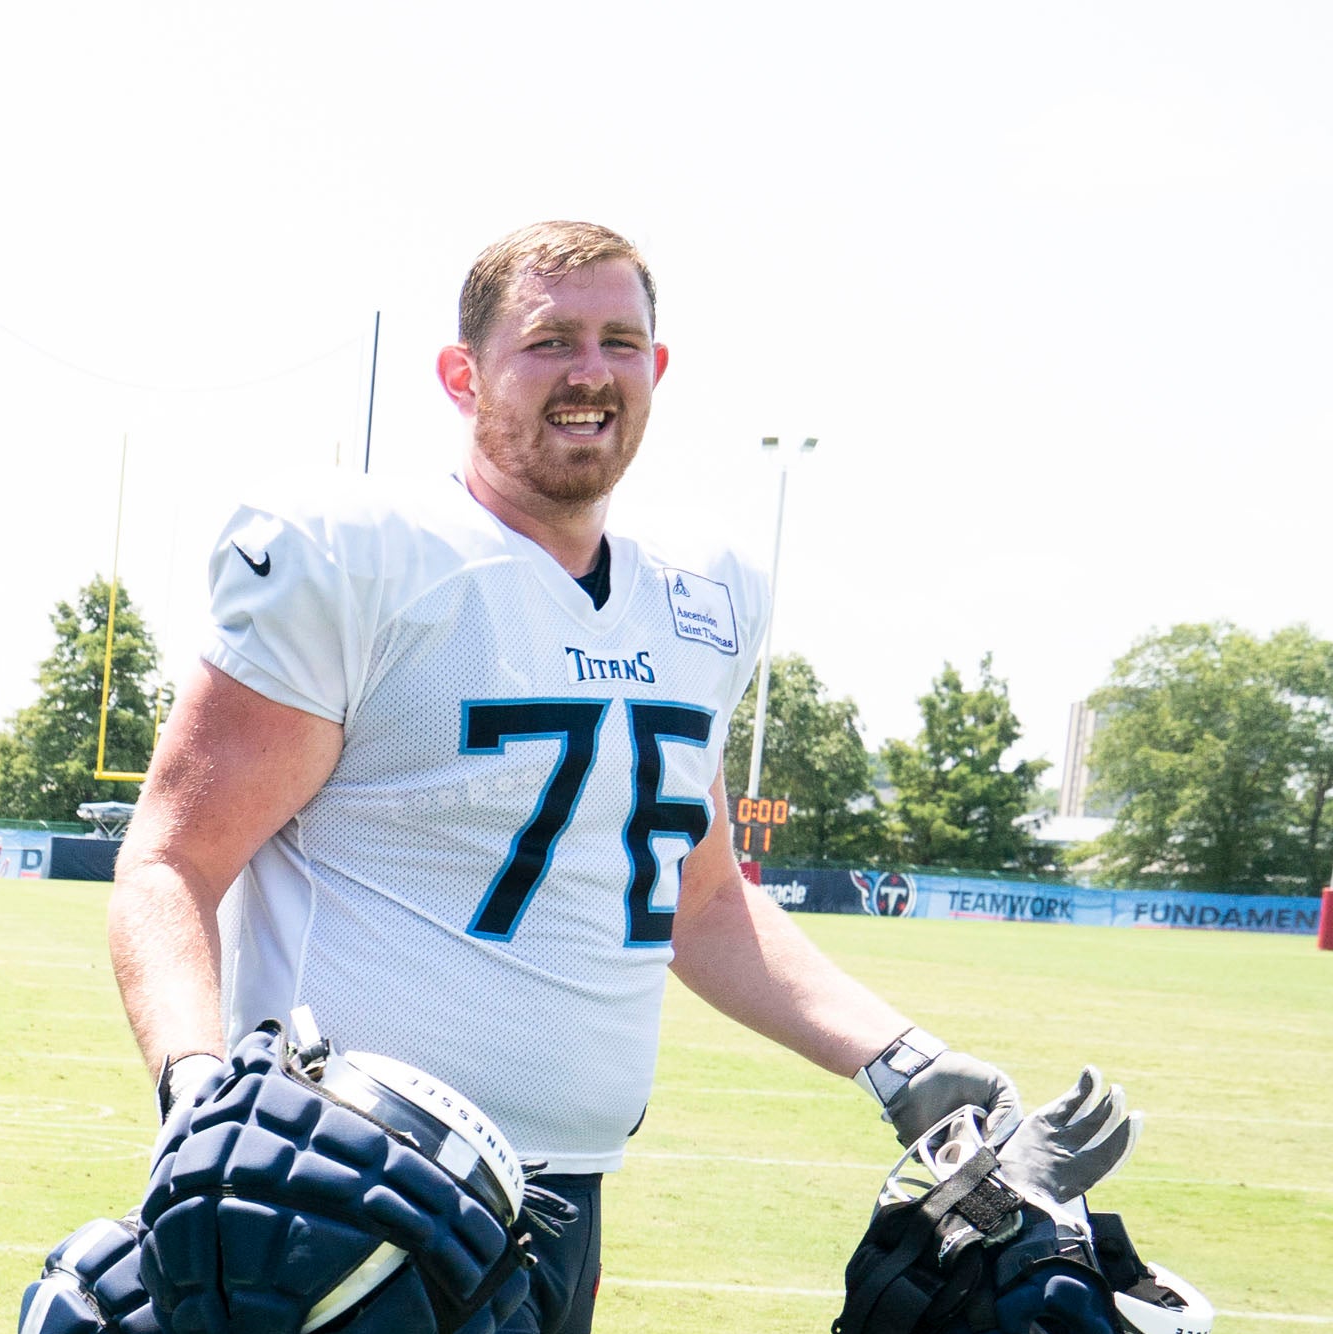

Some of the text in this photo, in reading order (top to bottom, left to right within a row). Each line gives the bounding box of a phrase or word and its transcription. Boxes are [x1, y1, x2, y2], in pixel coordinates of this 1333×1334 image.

[677, 606, 718, 628] Ascension
[679, 621, 702, 636] Saint
[459, 698, 719, 948] 76
[737, 798, 789, 825] 0:00
[743, 826, 772, 853] 11
[762, 880, 808, 905] nacle
[949, 890, 1073, 919] TEAMWORK
